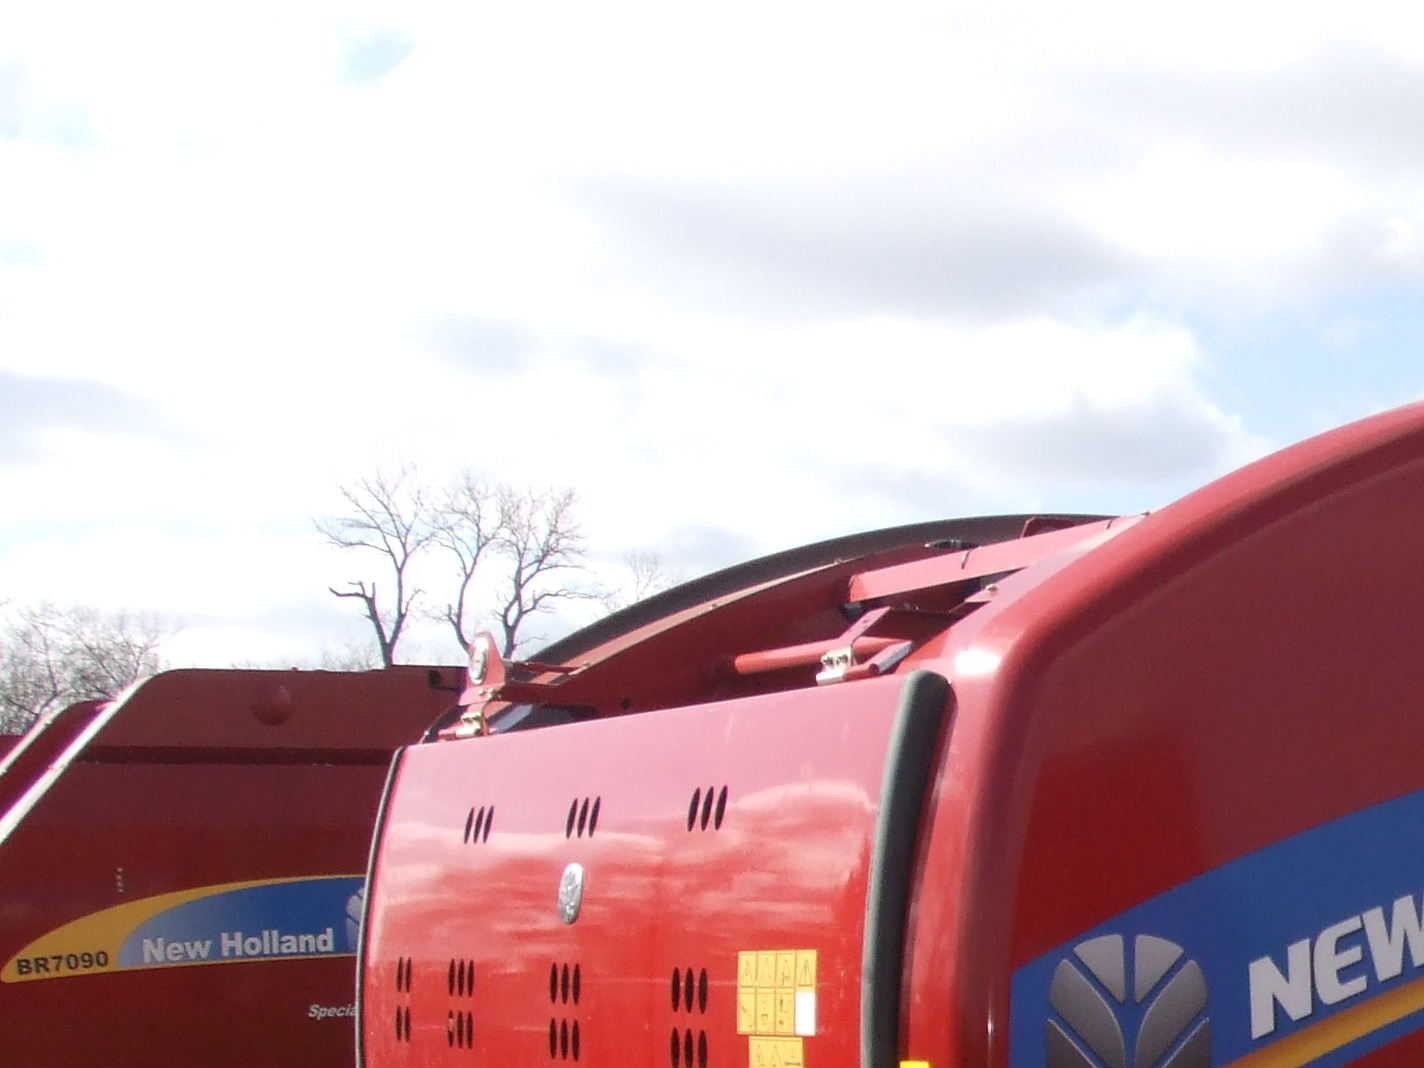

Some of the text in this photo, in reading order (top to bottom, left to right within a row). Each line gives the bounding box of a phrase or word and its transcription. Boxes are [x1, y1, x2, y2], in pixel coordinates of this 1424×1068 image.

[142, 927, 335, 964] New Holland
[16, 950, 109, 976] BR7090
